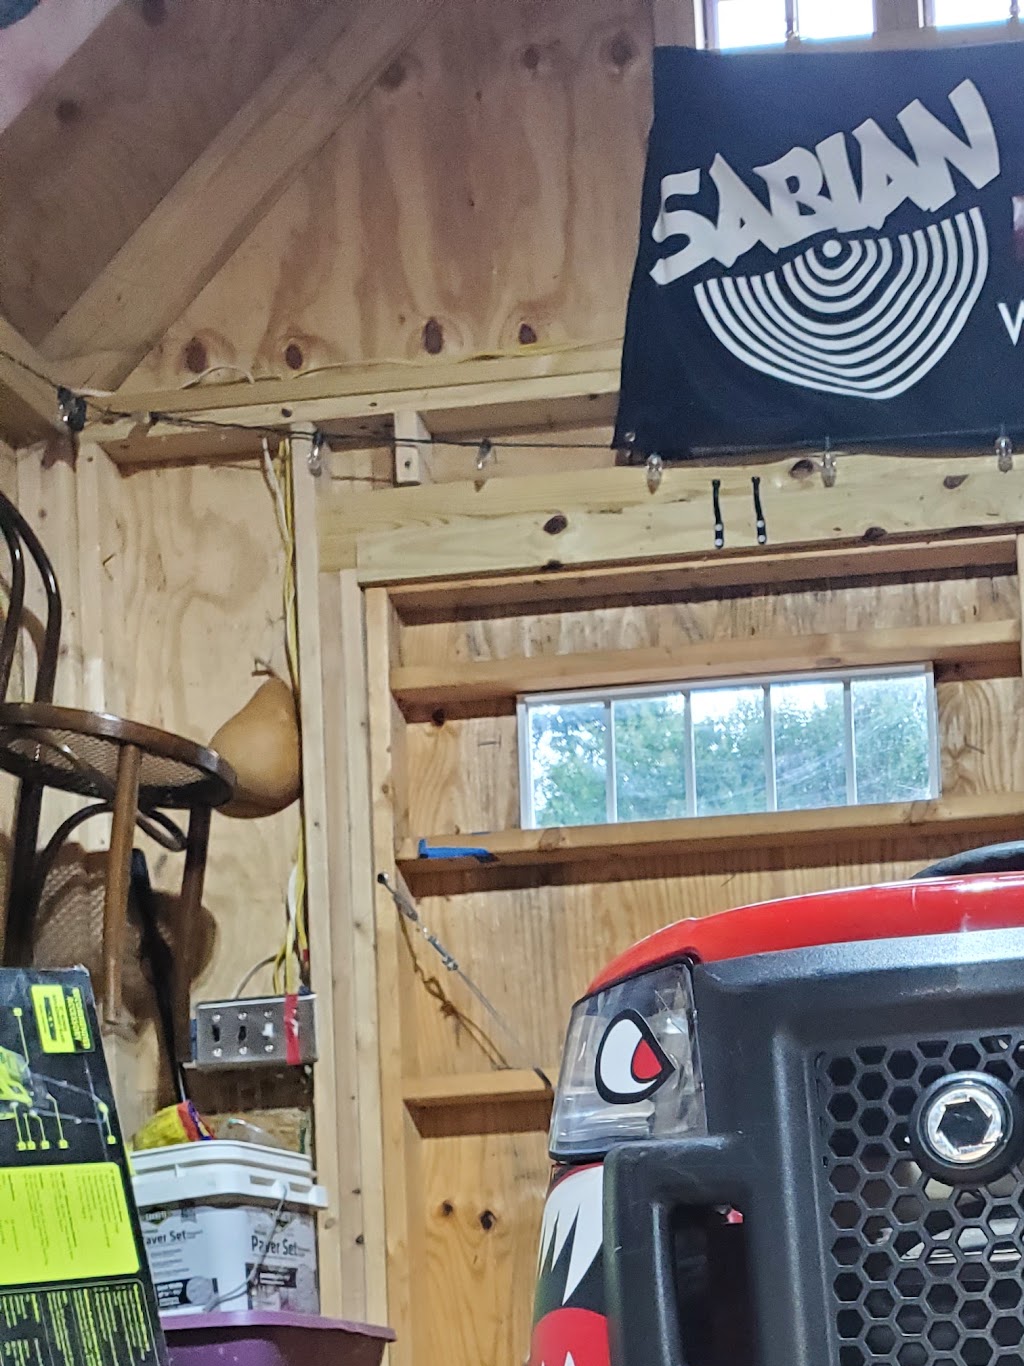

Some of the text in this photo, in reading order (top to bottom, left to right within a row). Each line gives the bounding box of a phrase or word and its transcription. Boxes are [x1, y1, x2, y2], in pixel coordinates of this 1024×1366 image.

[649, 78, 1001, 286] SABIAN
[146, 1233, 167, 1245] aver
[169, 1229, 186, 1243] Set
[282, 1238, 298, 1256] Set
